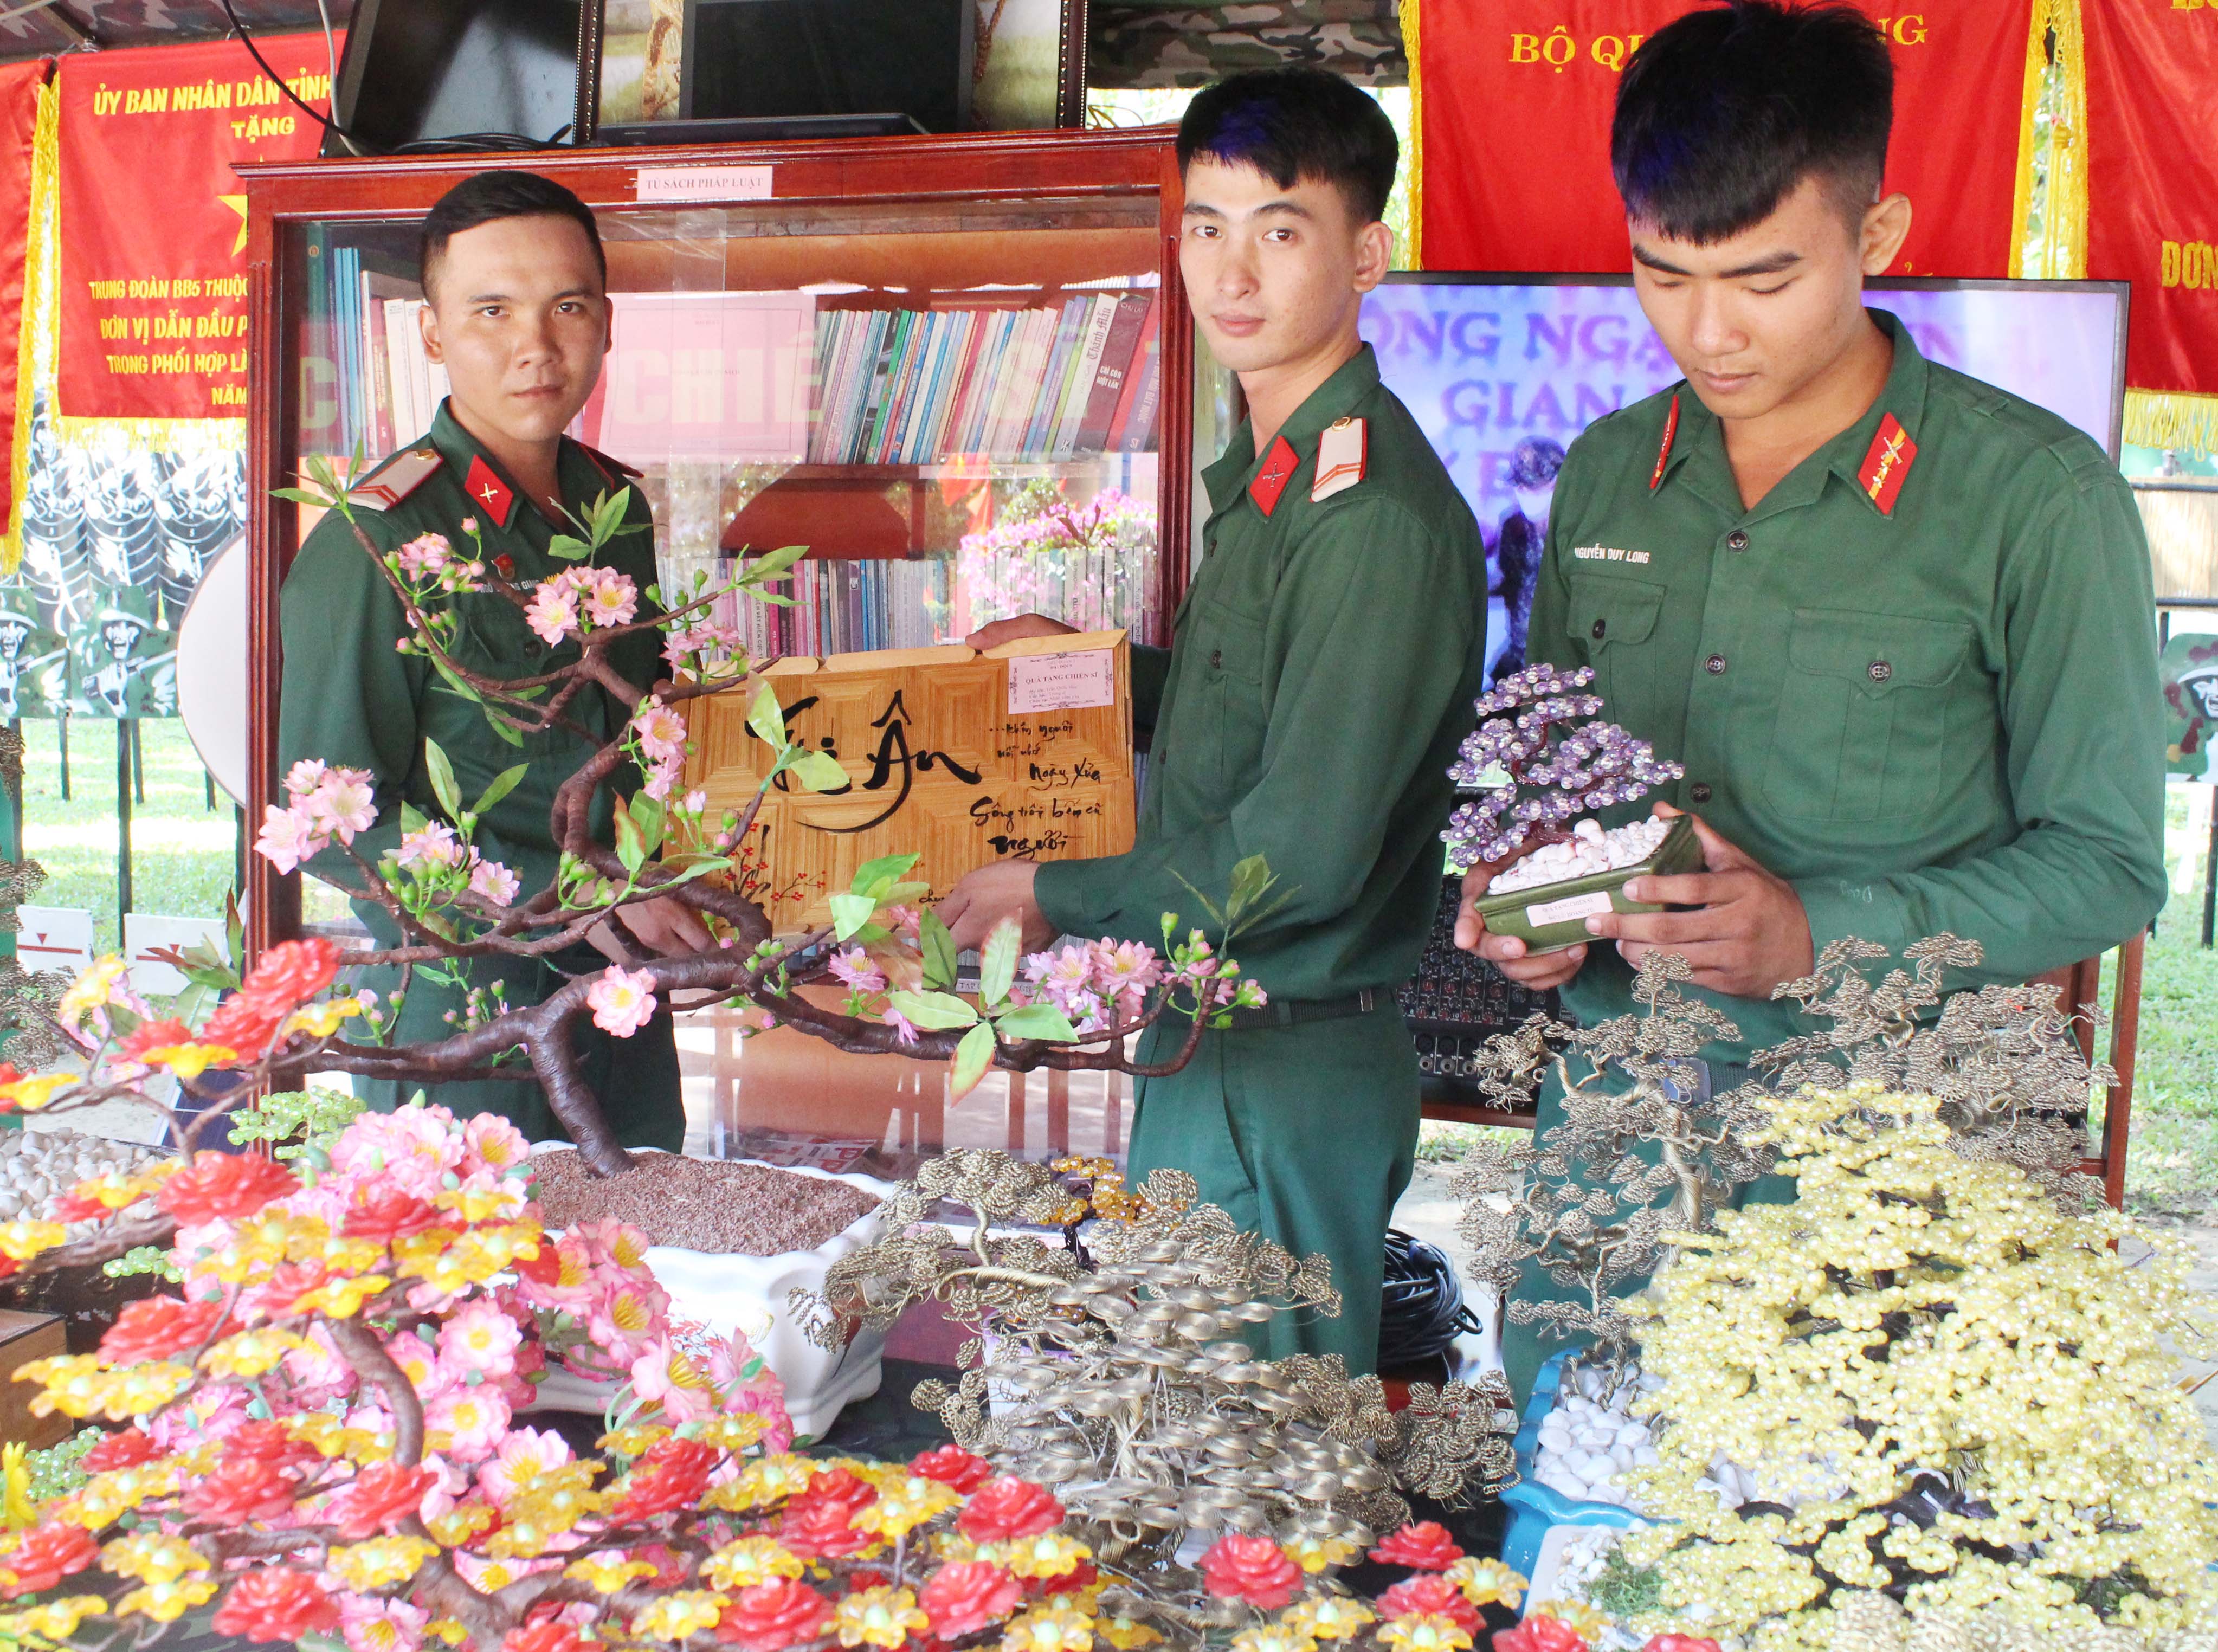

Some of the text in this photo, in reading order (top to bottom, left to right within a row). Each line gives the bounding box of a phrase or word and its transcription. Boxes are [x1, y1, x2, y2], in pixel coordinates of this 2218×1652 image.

[1509, 27, 1576, 73] BỘ
[93, 83, 122, 115] ỦY
[125, 87, 168, 114] BAN
[172, 79, 231, 111] NHÂN
[236, 75, 280, 107] DÂN
[230, 115, 295, 143] TẶNG
[663, 177, 694, 189] SÁCH
[698, 177, 729, 188] PHÁP
[732, 177, 763, 188] LUẬT
[88, 280, 126, 299] TRUNG
[128, 275, 169, 299] ĐOÀN
[173, 279, 201, 298] BB5
[100, 314, 128, 339] ĐƠN
[132, 317, 149, 345] VỊ
[154, 308, 192, 338] DẪN
[196, 307, 234, 338] ĐẦU
[106, 355, 148, 374] TRONG
[151, 346, 190, 374] PHỐI
[194, 351, 227, 377] HỢP
[211, 383, 248, 405] NĂM
[1574, 543, 1650, 564] NGUYỄN DUY LONG
[1026, 676, 1041, 685] QUÀ
[1044, 674, 1063, 683] TẶNG
[794, 689, 982, 833] Ân
[970, 796, 1014, 833] Sông
